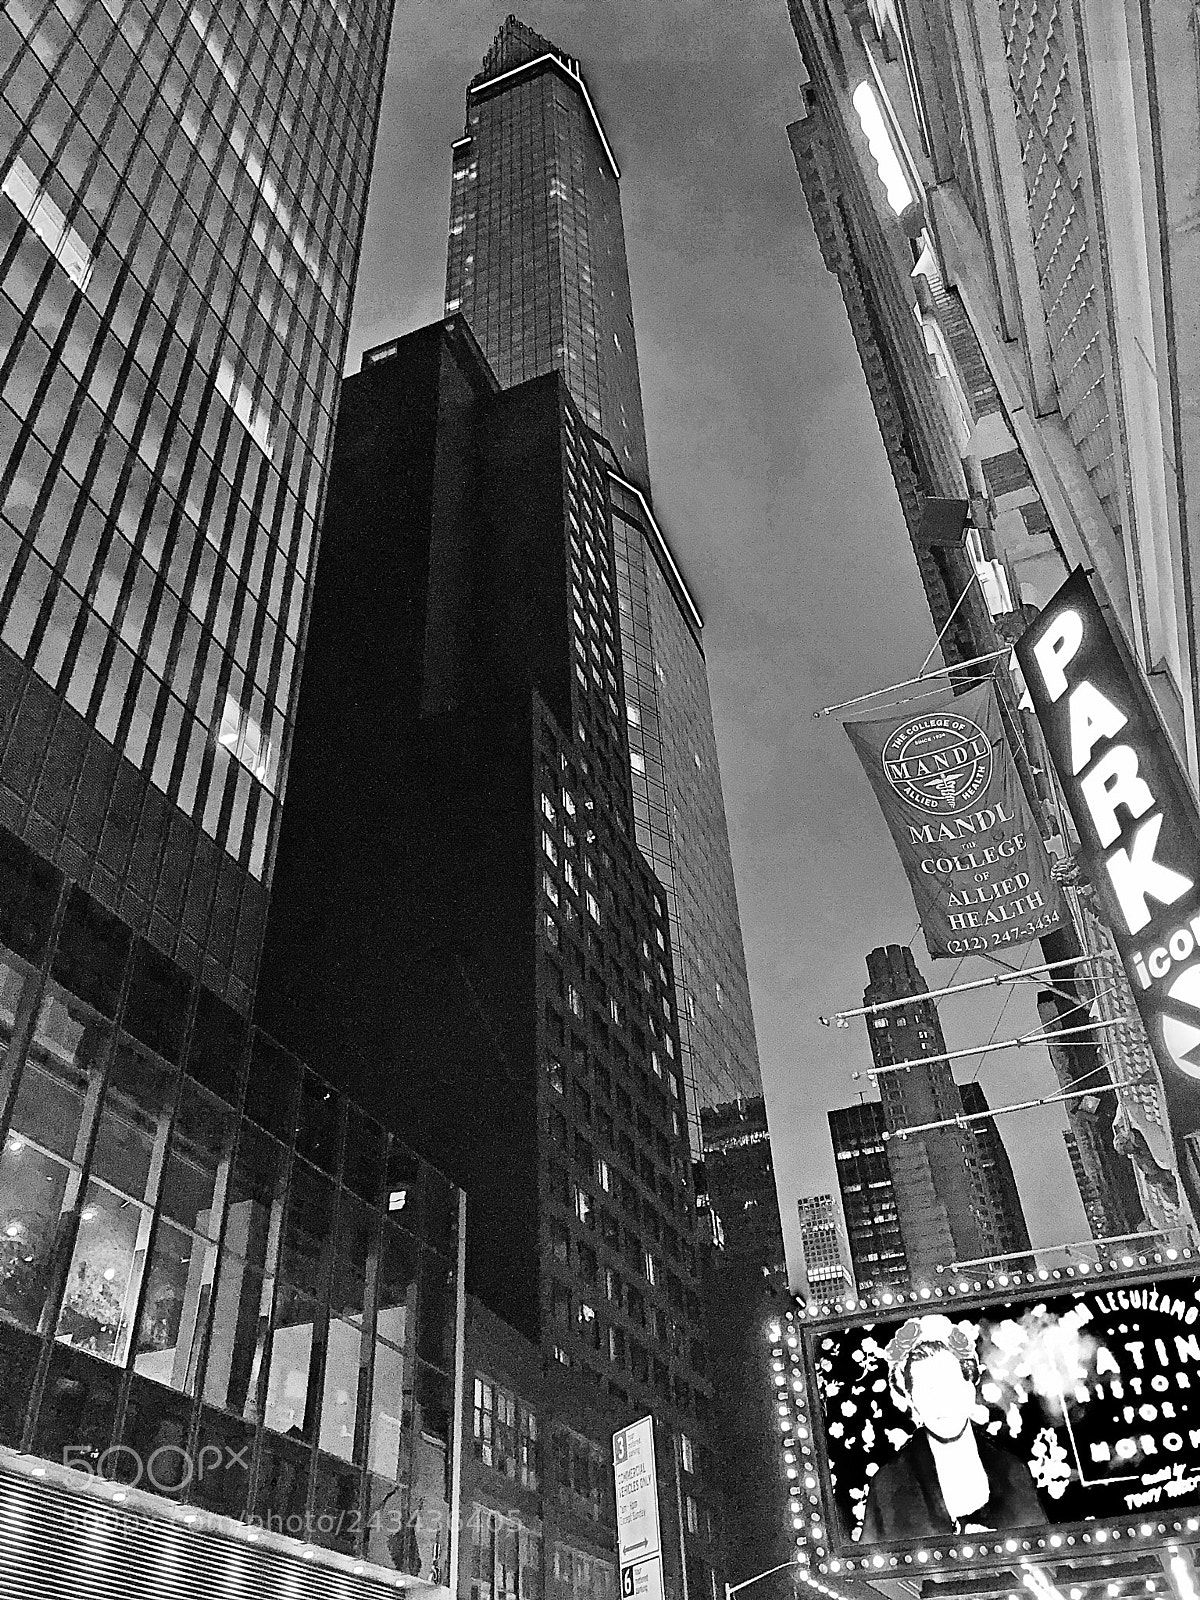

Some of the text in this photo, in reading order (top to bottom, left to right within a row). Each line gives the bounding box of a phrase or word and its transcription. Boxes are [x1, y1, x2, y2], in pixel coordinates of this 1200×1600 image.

[891, 720, 966, 749] THE COLLEGE OF
[915, 736, 931, 745] SINCE
[889, 740, 986, 779] MANDL
[1033, 609, 1195, 936] PARK
[903, 765, 986, 808] ALLIED HEALTH
[907, 802, 1015, 845] MANDL
[921, 833, 1027, 874] COLLEGE
[948, 872, 1030, 907] ALLIED
[974, 871, 990, 882] OF
[948, 890, 1045, 930] HEALTH
[947, 910, 1060, 955] (212) 247-3434
[1095, 1287, 1199, 1325] LEGUIZAMO
[1073, 1334, 1200, 1378] ATIN
[1074, 1370, 1200, 1404] HISTOR
[1123, 1401, 1177, 1424] FOR
[616, 1436, 625, 1460] 3
[624, 1568, 632, 1595] 6
